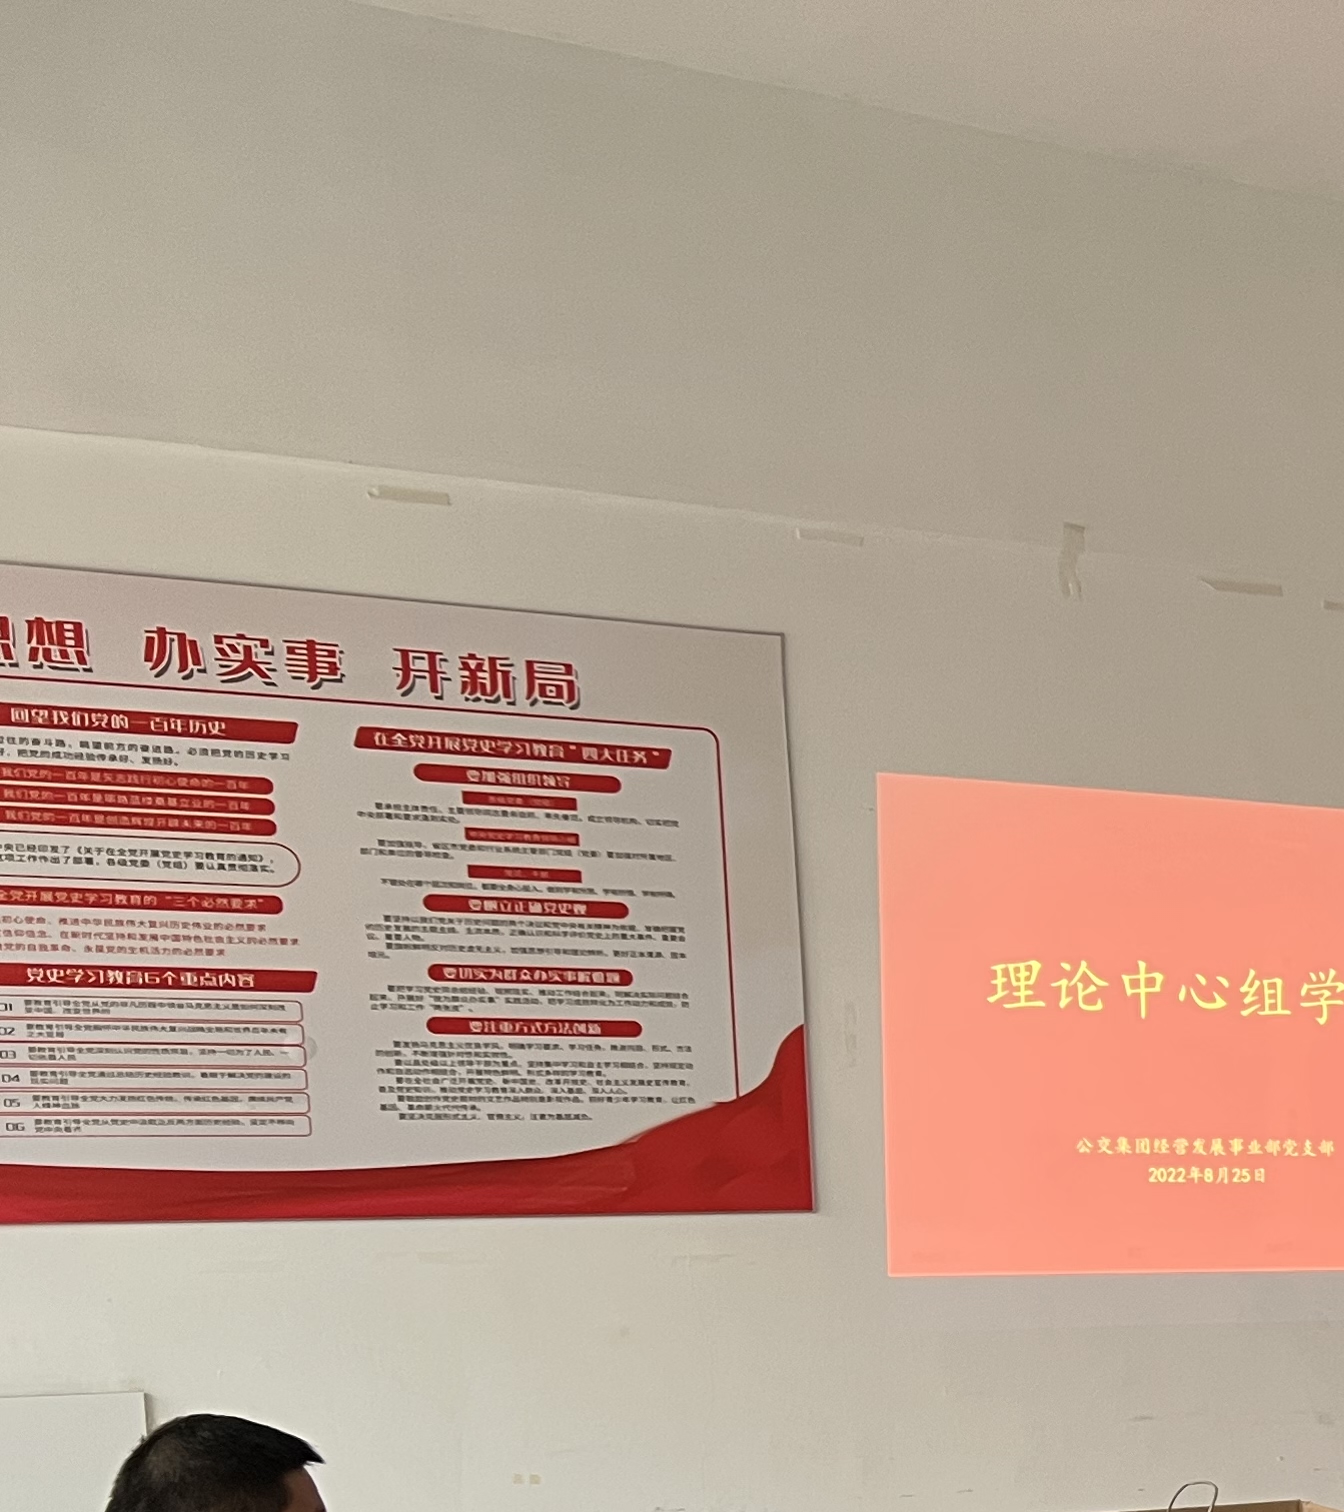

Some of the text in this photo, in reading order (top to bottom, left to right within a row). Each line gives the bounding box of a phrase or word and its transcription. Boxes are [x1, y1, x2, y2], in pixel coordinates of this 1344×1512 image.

[0, 614, 583, 708] 想 办实事 开新局
[10, 708, 226, 736] 回望我们党的一百年历史
[26, 967, 256, 989] 党史学习教育6个重点内容
[2, 1073, 20, 1083] 04
[3, 1098, 21, 1108] 05
[5, 1122, 26, 1132] 06
[1075, 1135, 1335, 1158] 公交集团经营发展事业部党支部
[1147, 1166, 1266, 1185] 2022年8月25日
